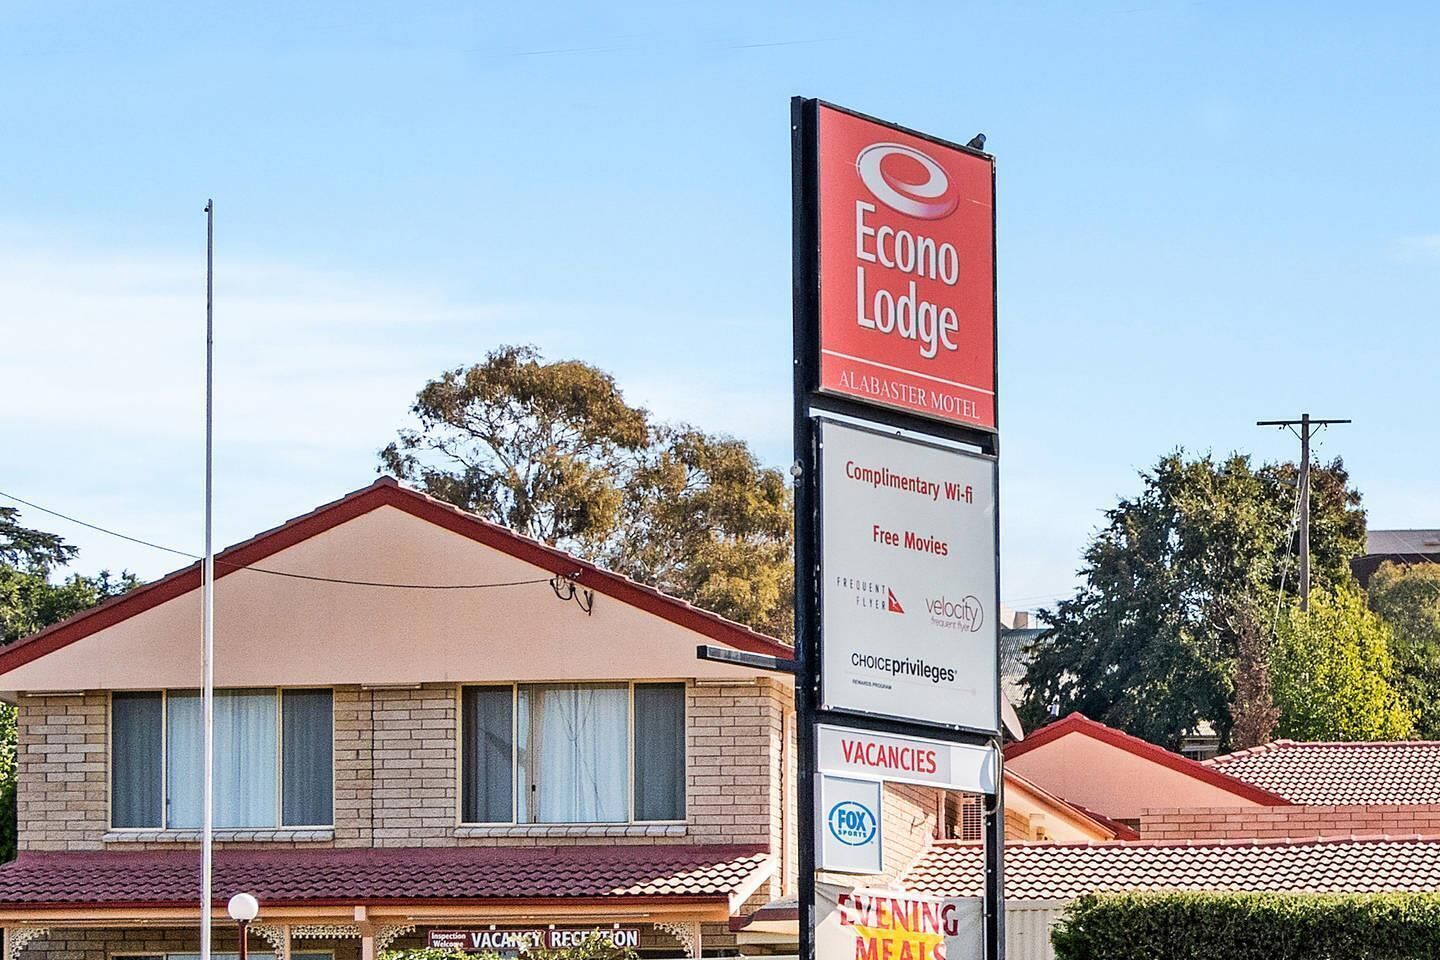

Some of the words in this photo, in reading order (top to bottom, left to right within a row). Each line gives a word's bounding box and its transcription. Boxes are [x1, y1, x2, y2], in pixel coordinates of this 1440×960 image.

[855, 200, 959, 286] Econo
[856, 266, 958, 359] Lodge
[839, 370, 927, 407] ALABASTER
[931, 393, 980, 419] MOTEL
[845, 461, 940, 500] Complimentary
[944, 481, 973, 504] Wi-fi
[873, 525, 899, 546] Free
[904, 531, 948, 556] Movies
[836, 576, 886, 594] FREQUENT
[856, 596, 886, 610] FLYER
[925, 595, 984, 632] velocity
[841, 739, 937, 774] VACANCIES
[838, 808, 866, 832] FOX
[838, 829, 867, 839] SPORTS
[838, 894, 959, 937] EVENING
[432, 932, 466, 940] Inspection
[433, 940, 464, 948] Welcome
[551, 931, 638, 947] RECETON
